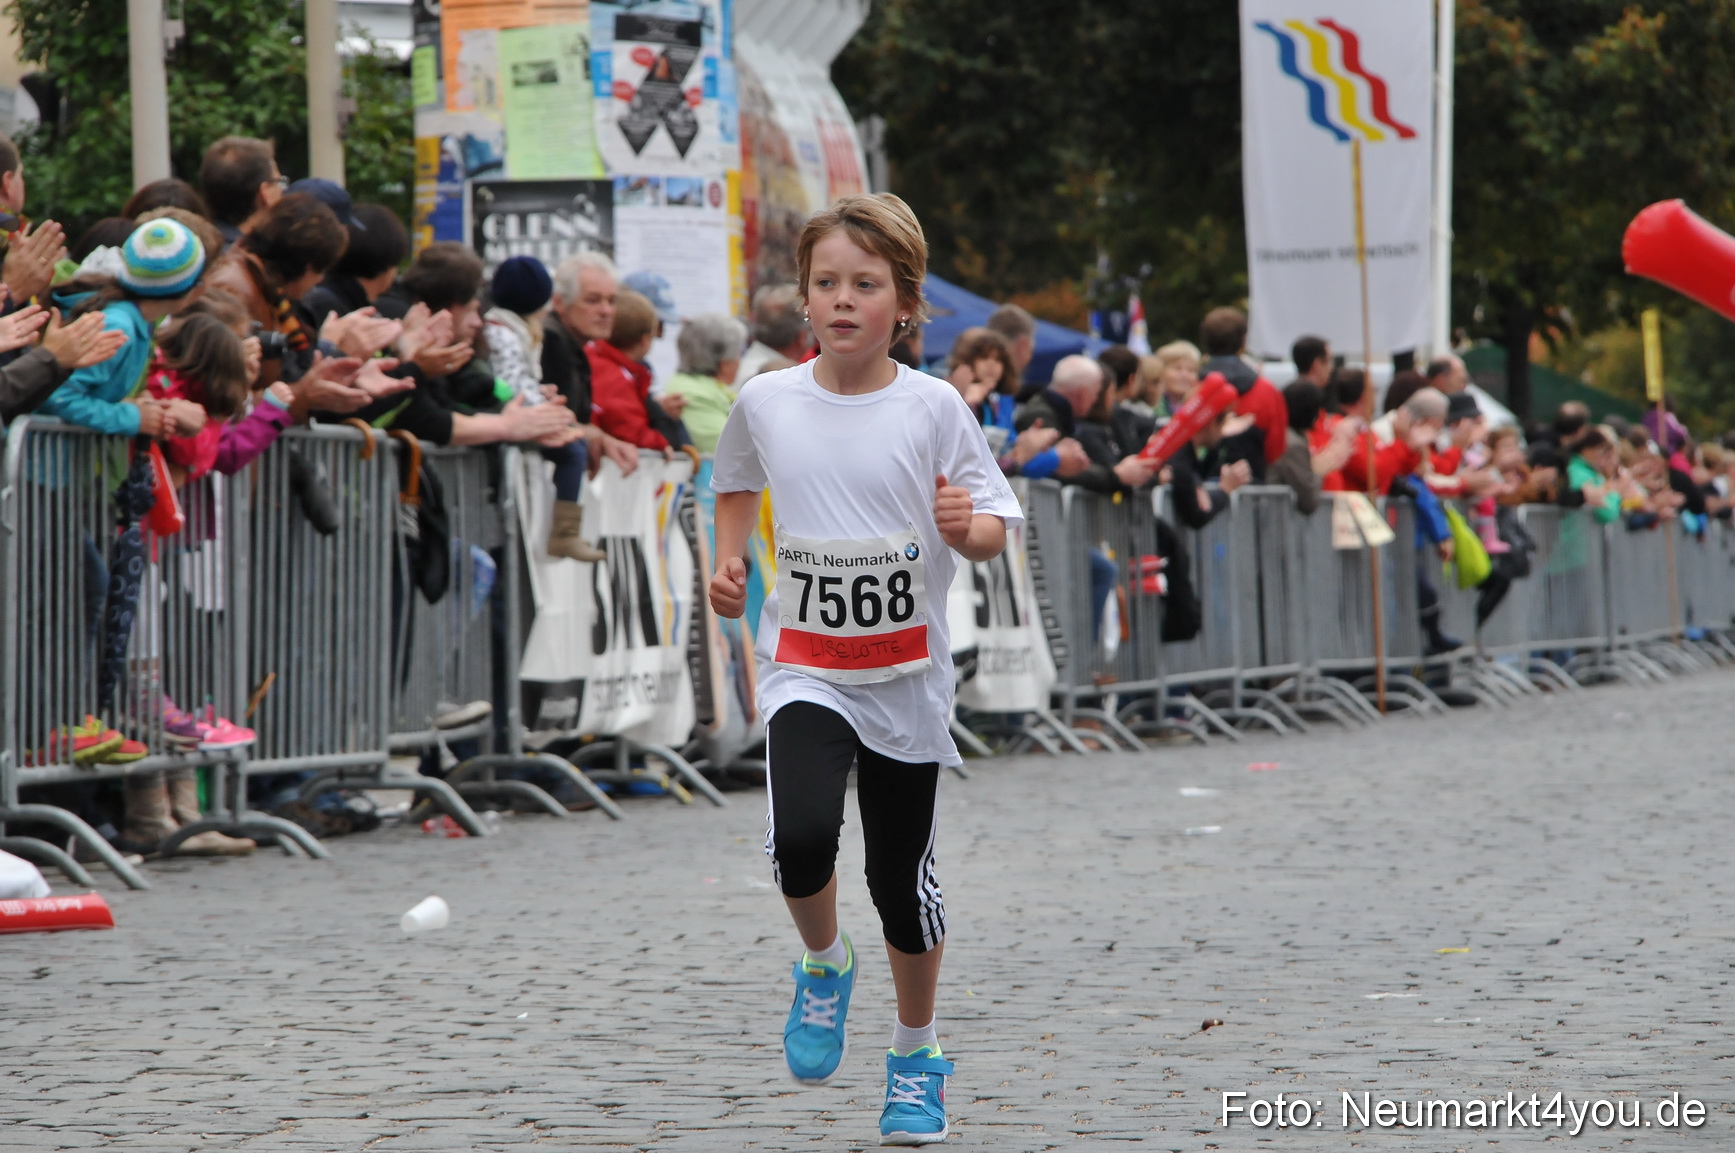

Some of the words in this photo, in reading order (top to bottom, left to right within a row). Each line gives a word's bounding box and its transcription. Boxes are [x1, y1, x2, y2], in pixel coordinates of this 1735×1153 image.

[778, 546, 821, 566] PARTL
[823, 551, 900, 568] Neumarkt
[790, 569, 915, 629] 7568
[810, 637, 904, 660] LISELOTTE
